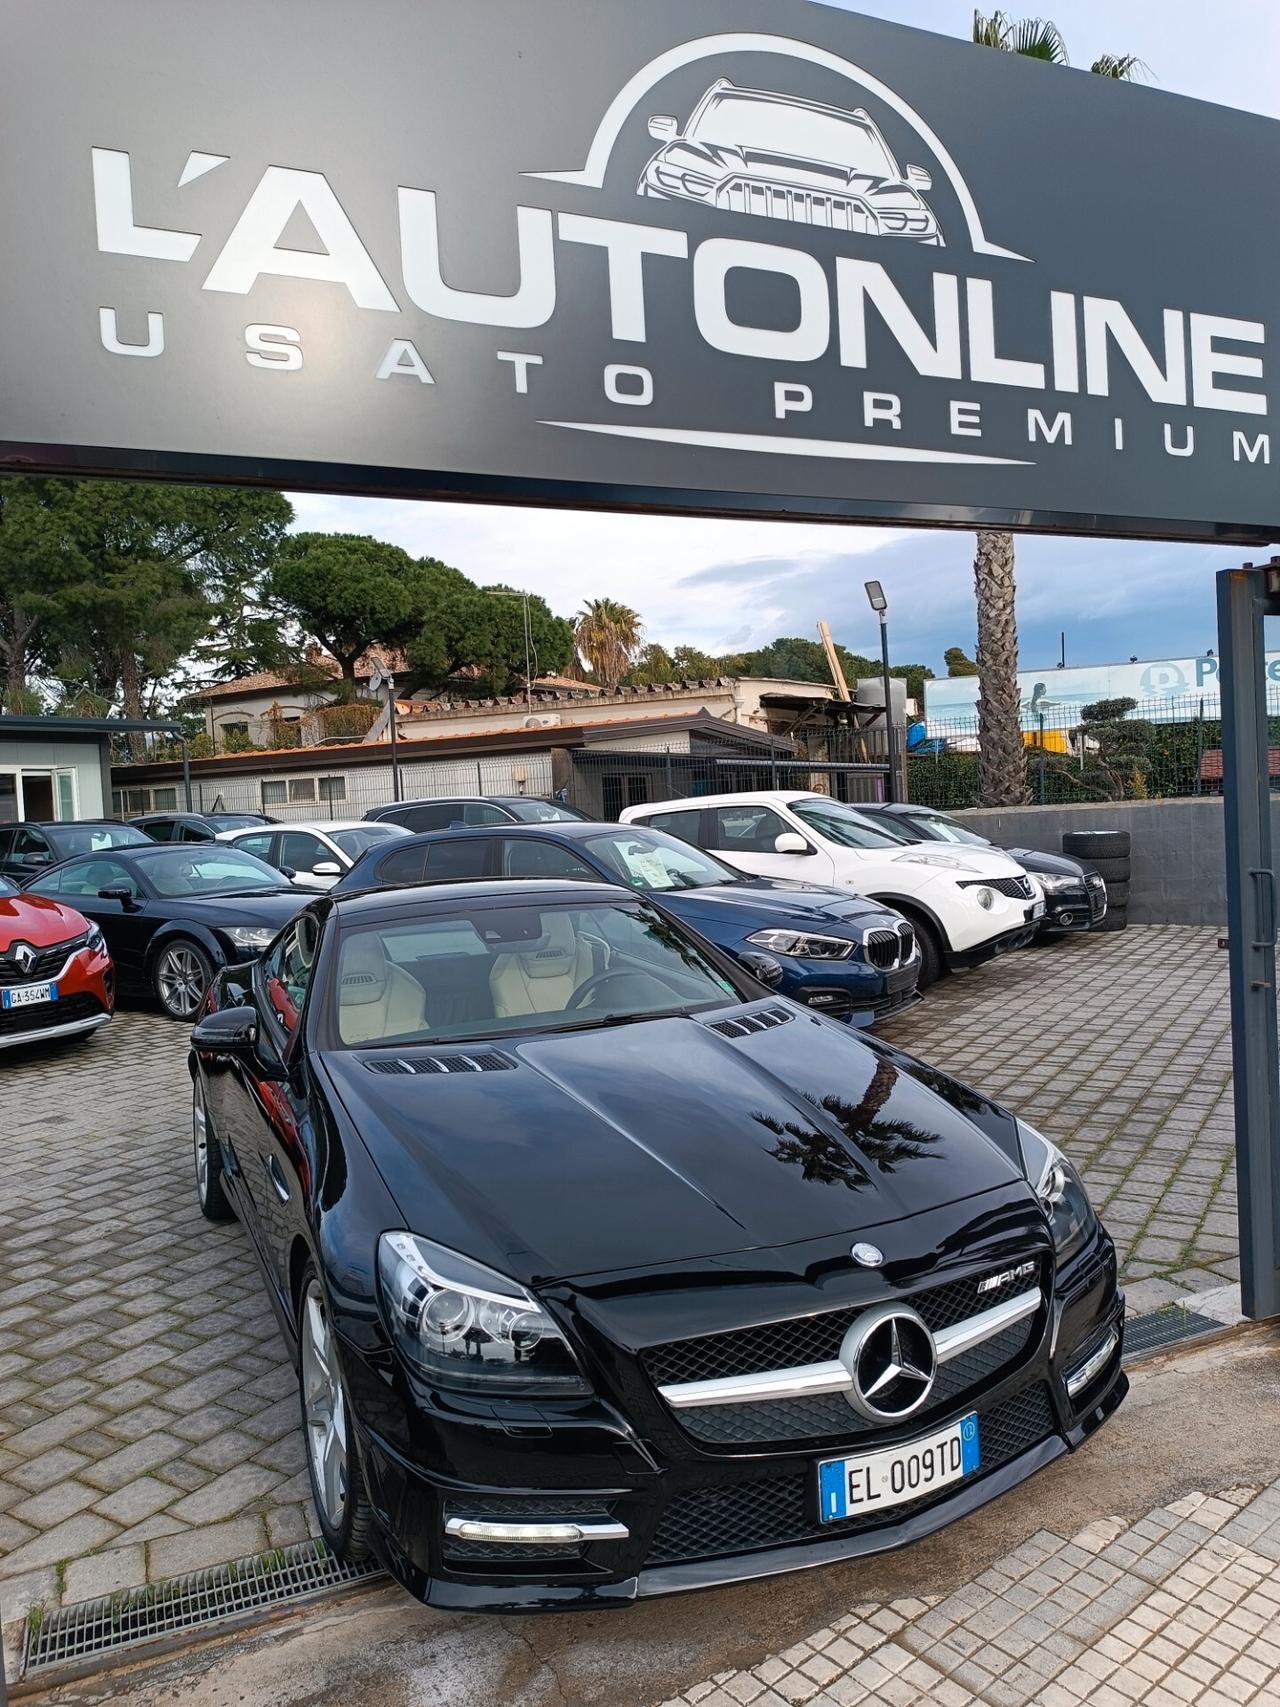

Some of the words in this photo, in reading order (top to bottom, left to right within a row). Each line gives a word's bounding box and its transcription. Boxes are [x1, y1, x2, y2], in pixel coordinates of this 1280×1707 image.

[91, 146, 1268, 416] L'AUTONLINE
[99, 306, 654, 407] USATO
[773, 381, 1271, 464] PREMIUM
[997, 1261, 1035, 1287] AMG
[848, 1466, 881, 1504] EL
[890, 1436, 962, 1494] 009TD
